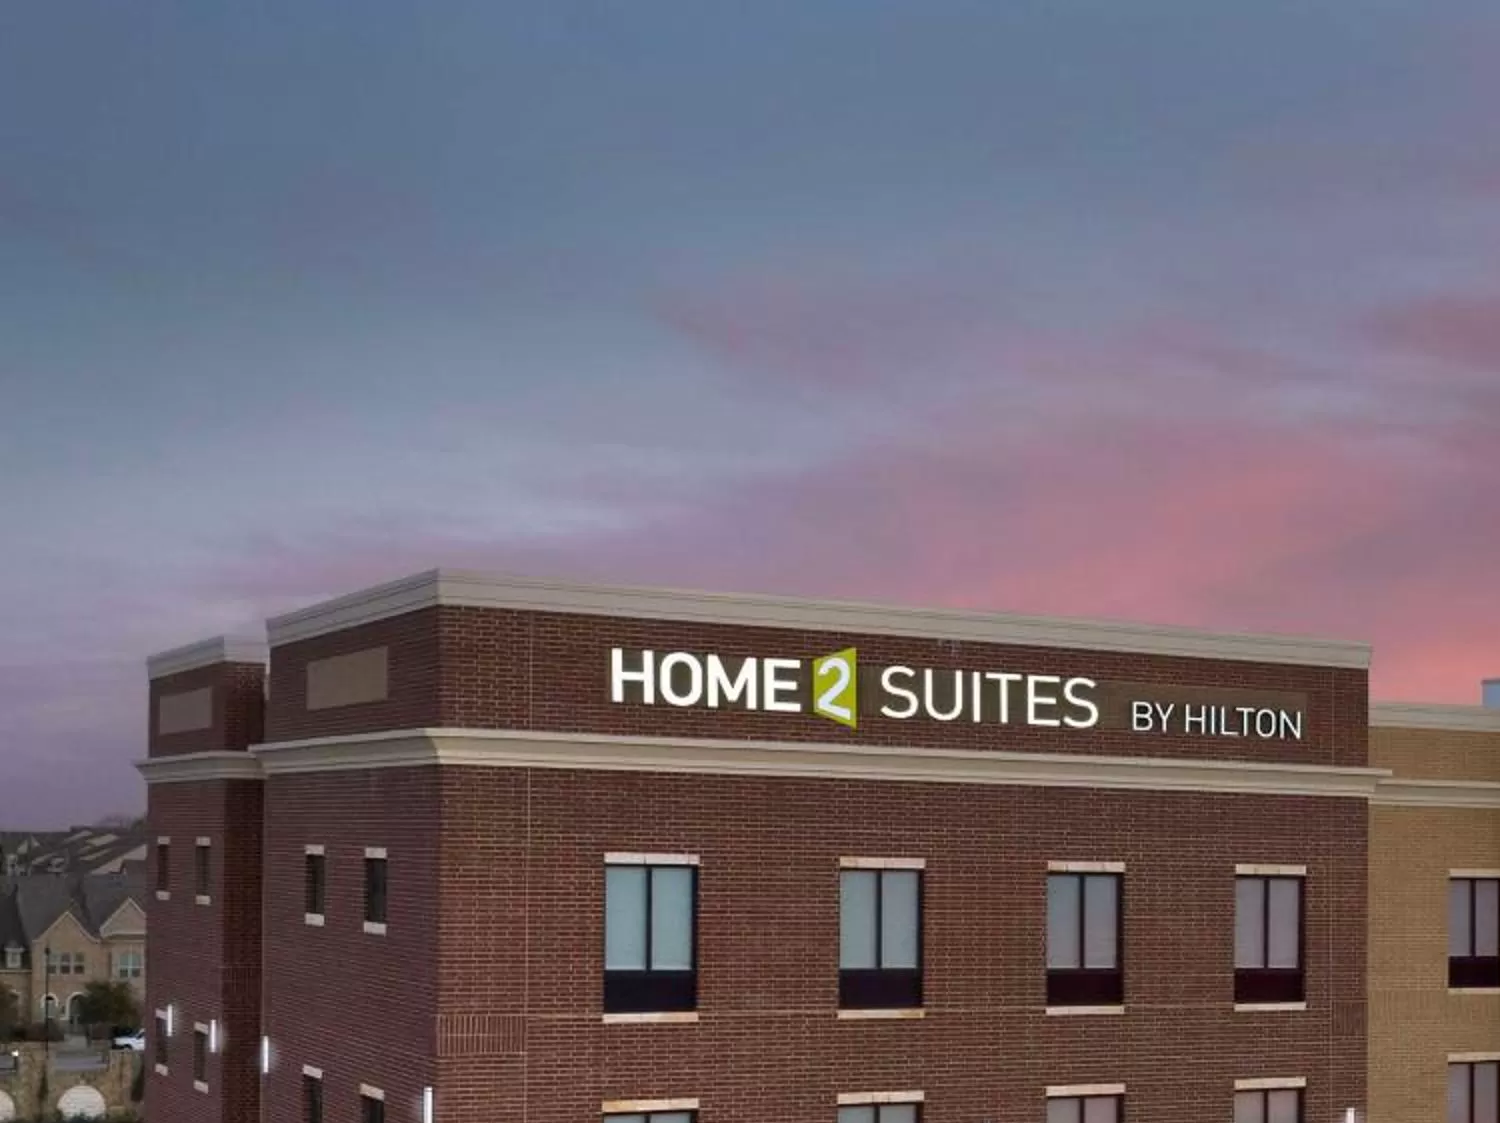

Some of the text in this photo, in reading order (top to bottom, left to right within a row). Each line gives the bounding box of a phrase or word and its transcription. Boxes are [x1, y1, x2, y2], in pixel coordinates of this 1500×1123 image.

[611, 647, 1302, 740] HOME 2 SUITES BY HILTON
